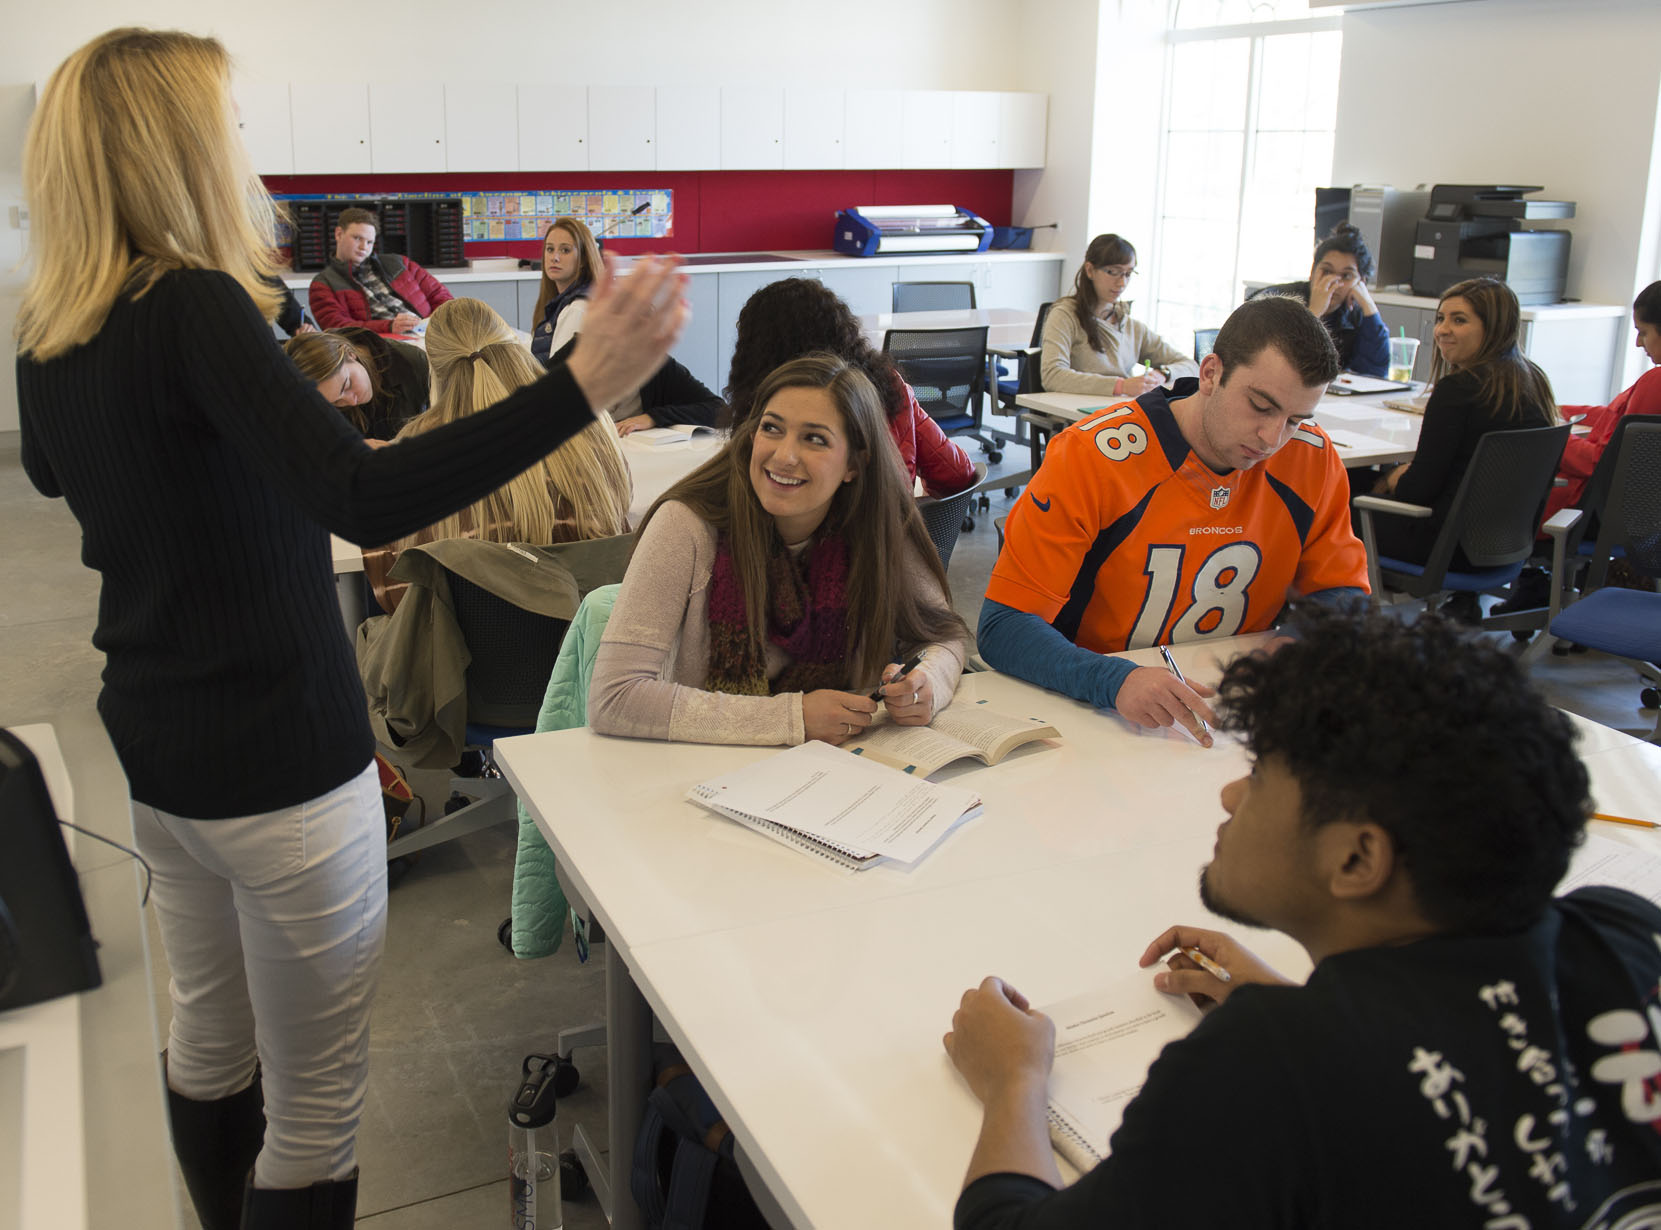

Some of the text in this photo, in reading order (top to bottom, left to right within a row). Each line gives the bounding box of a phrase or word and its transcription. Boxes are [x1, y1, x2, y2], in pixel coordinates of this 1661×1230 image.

[1078, 405, 1149, 462] 18
[1189, 526, 1243, 535] BRONCOS
[1125, 540, 1263, 652] 18
